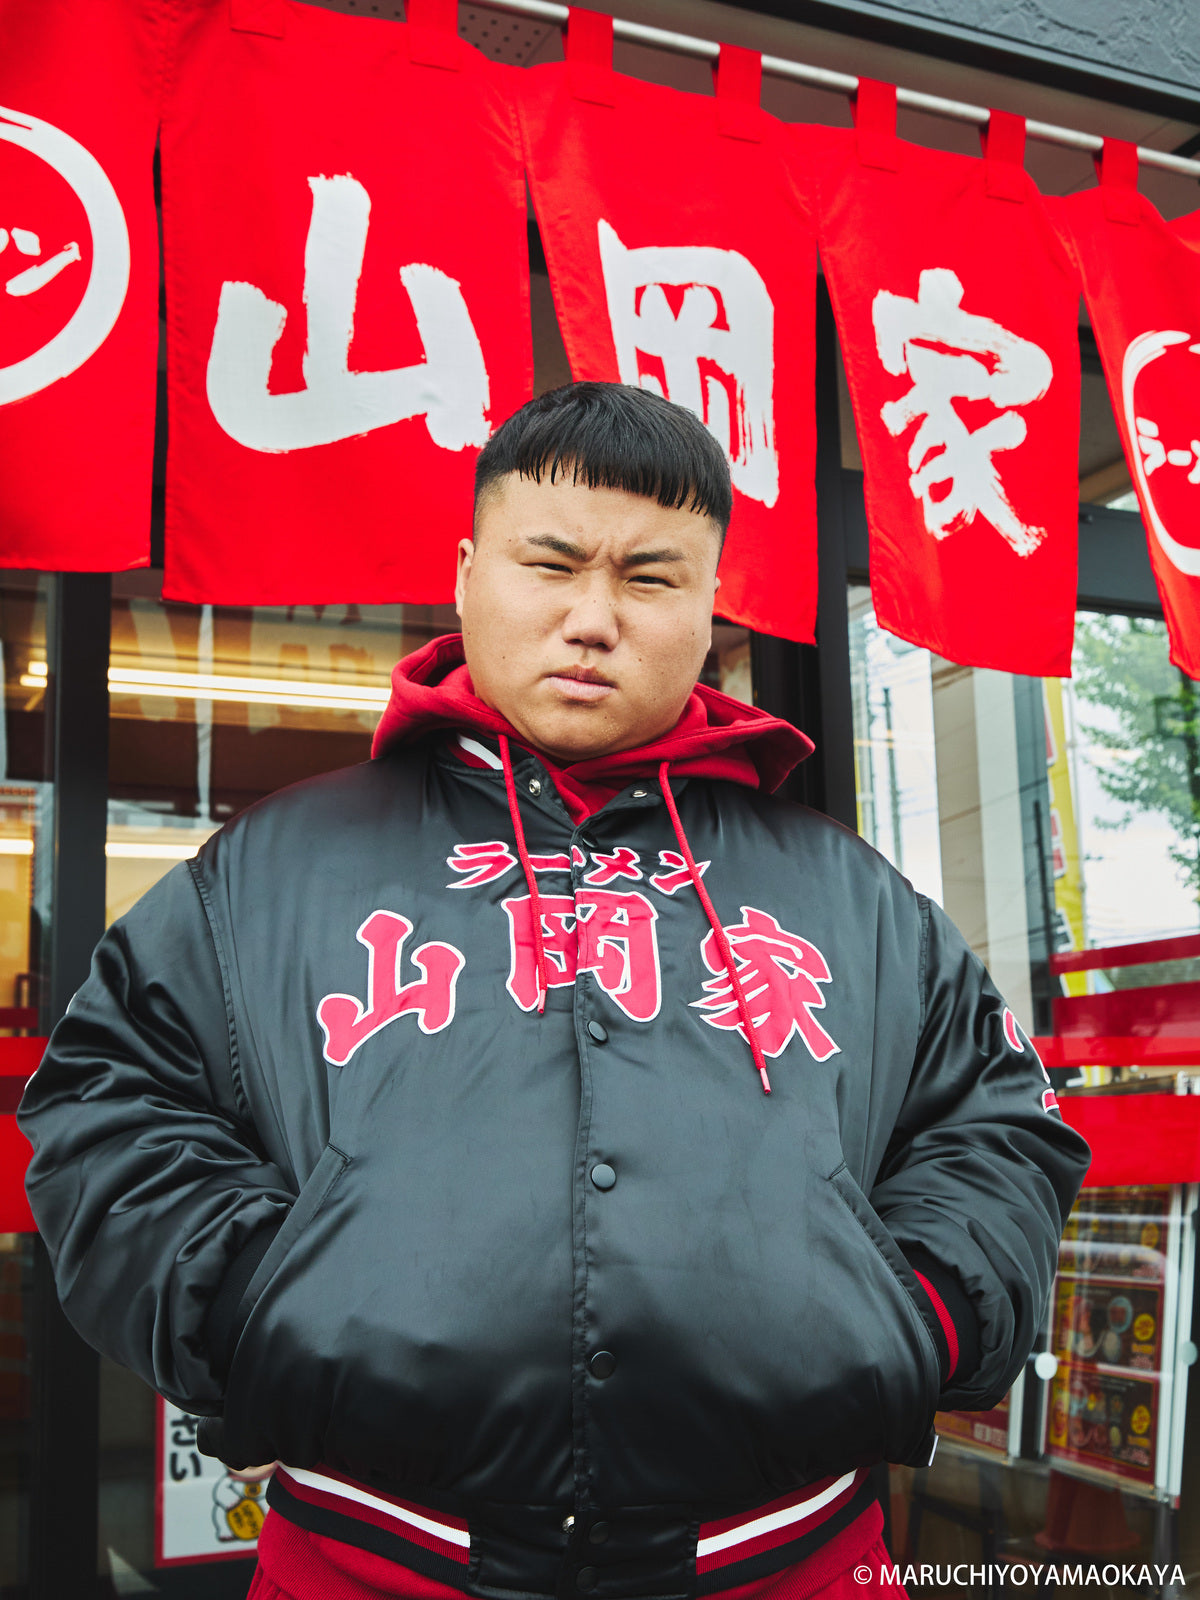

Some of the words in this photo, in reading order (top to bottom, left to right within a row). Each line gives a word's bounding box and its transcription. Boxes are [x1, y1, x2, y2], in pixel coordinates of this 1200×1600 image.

[0, 227, 82, 297] ン
[446, 841, 711, 895] ラーメン
[316, 888, 842, 1067] 山岡家
